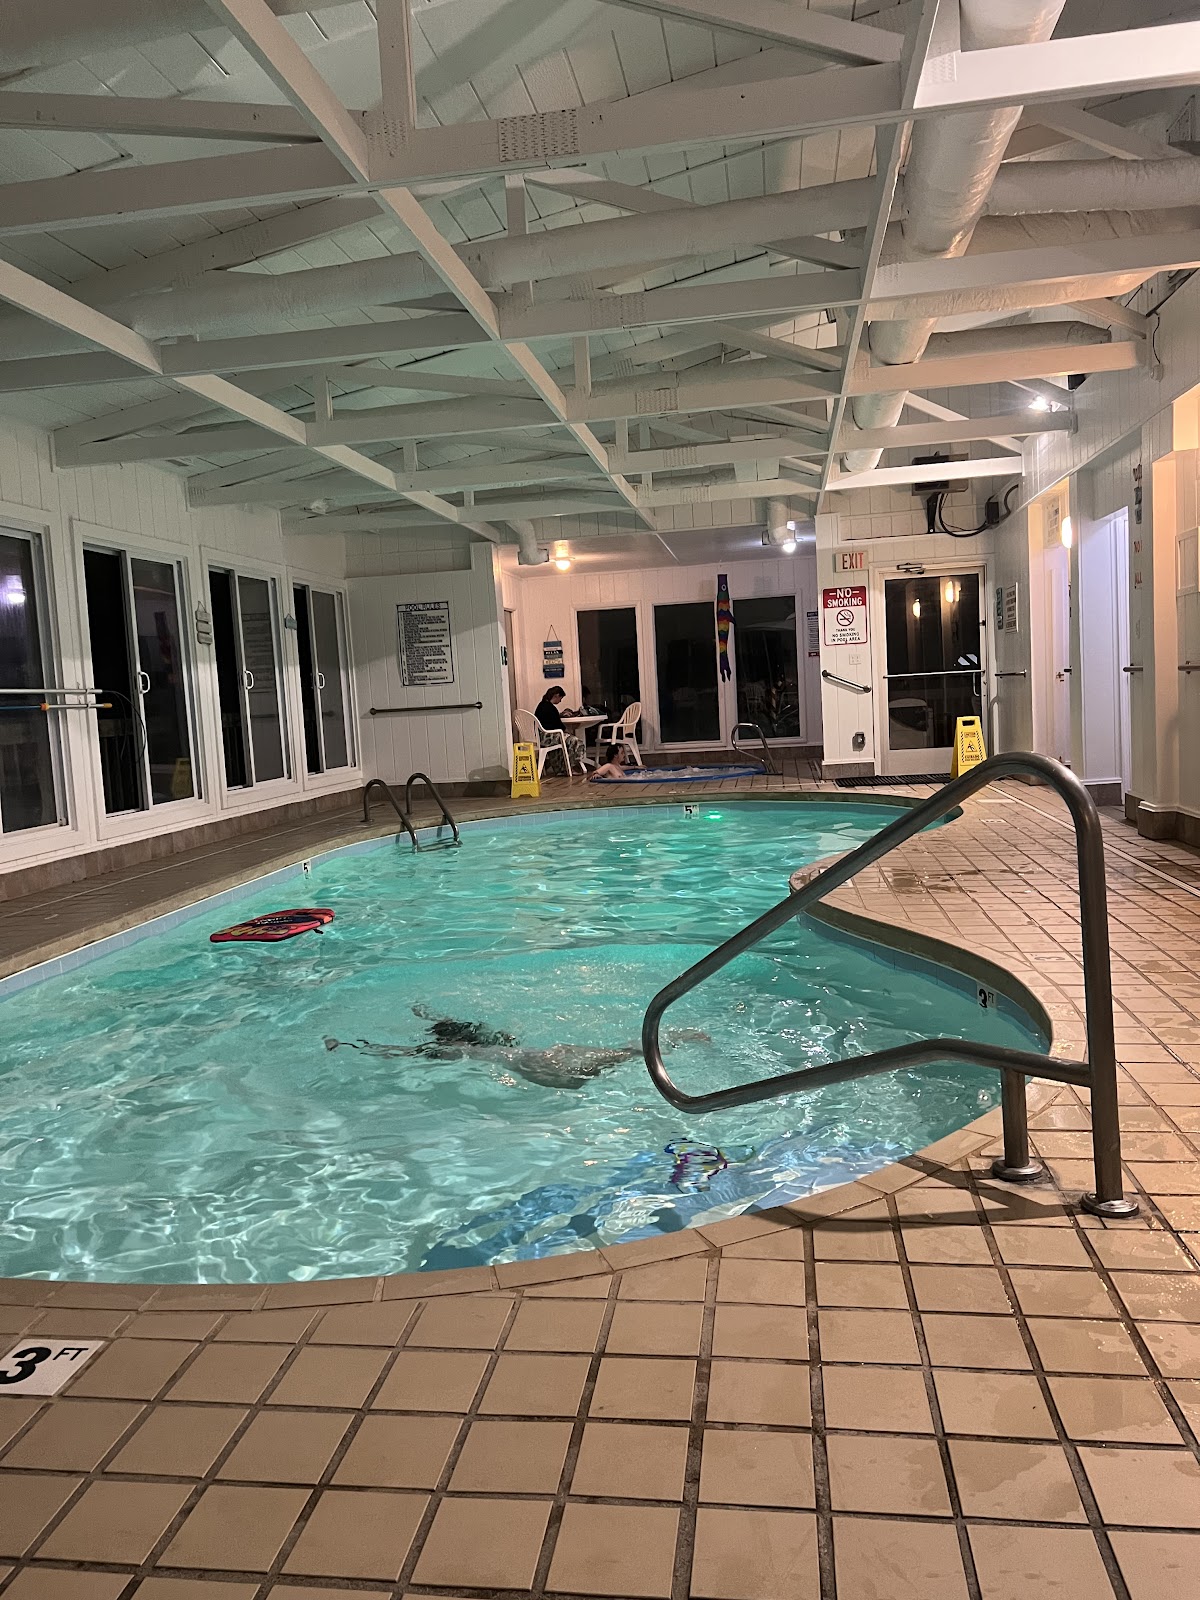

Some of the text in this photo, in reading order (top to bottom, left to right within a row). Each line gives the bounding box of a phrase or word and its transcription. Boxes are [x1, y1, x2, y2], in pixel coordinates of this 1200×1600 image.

[842, 553, 863, 570] EXIT
[836, 588, 852, 598] NO
[827, 597, 863, 608] SMOKING
[685, 805, 692, 814] 5
[304, 862, 309, 873] 5
[979, 988, 994, 1008] 3 FT
[0, 1347, 89, 1385] 3 FT
